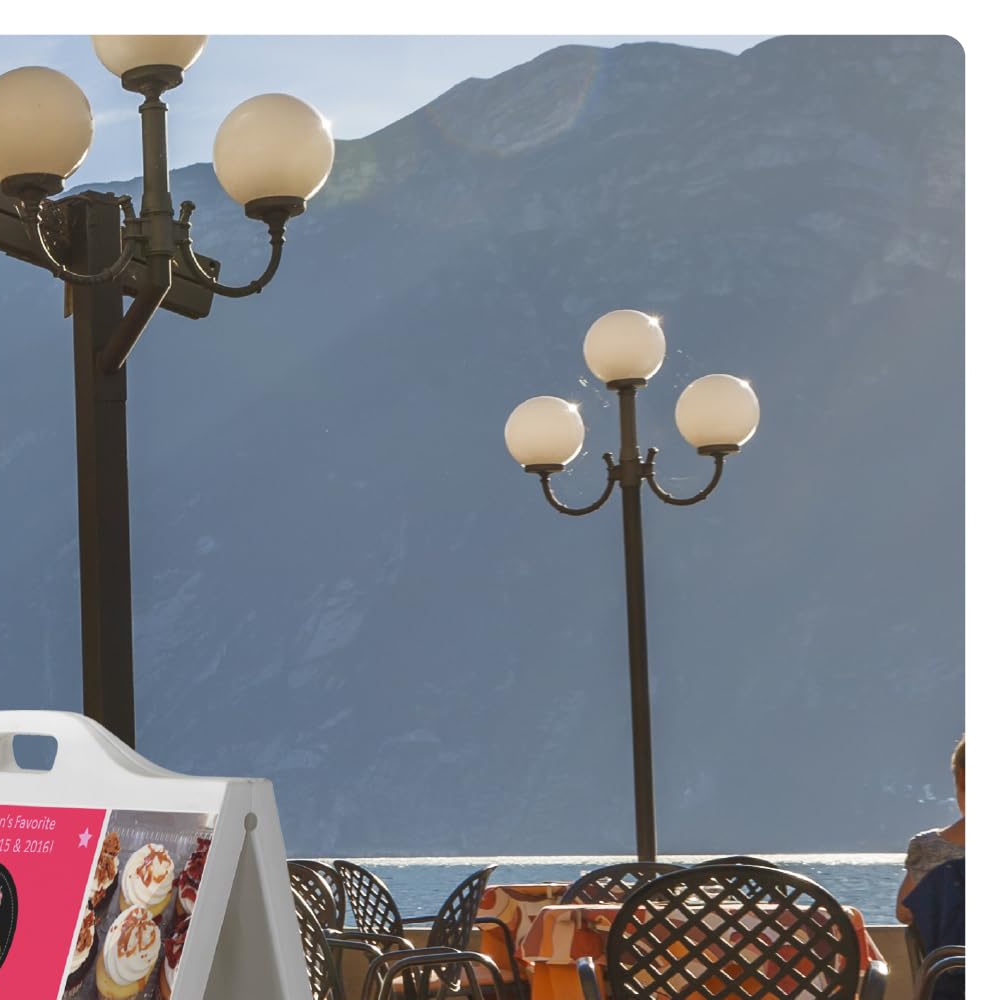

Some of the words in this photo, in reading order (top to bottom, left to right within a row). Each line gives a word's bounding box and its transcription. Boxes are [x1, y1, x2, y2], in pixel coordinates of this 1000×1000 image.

[14, 815, 57, 831] Favorite
[13, 838, 21, 853] &
[23, 839, 55, 854] 2016!
